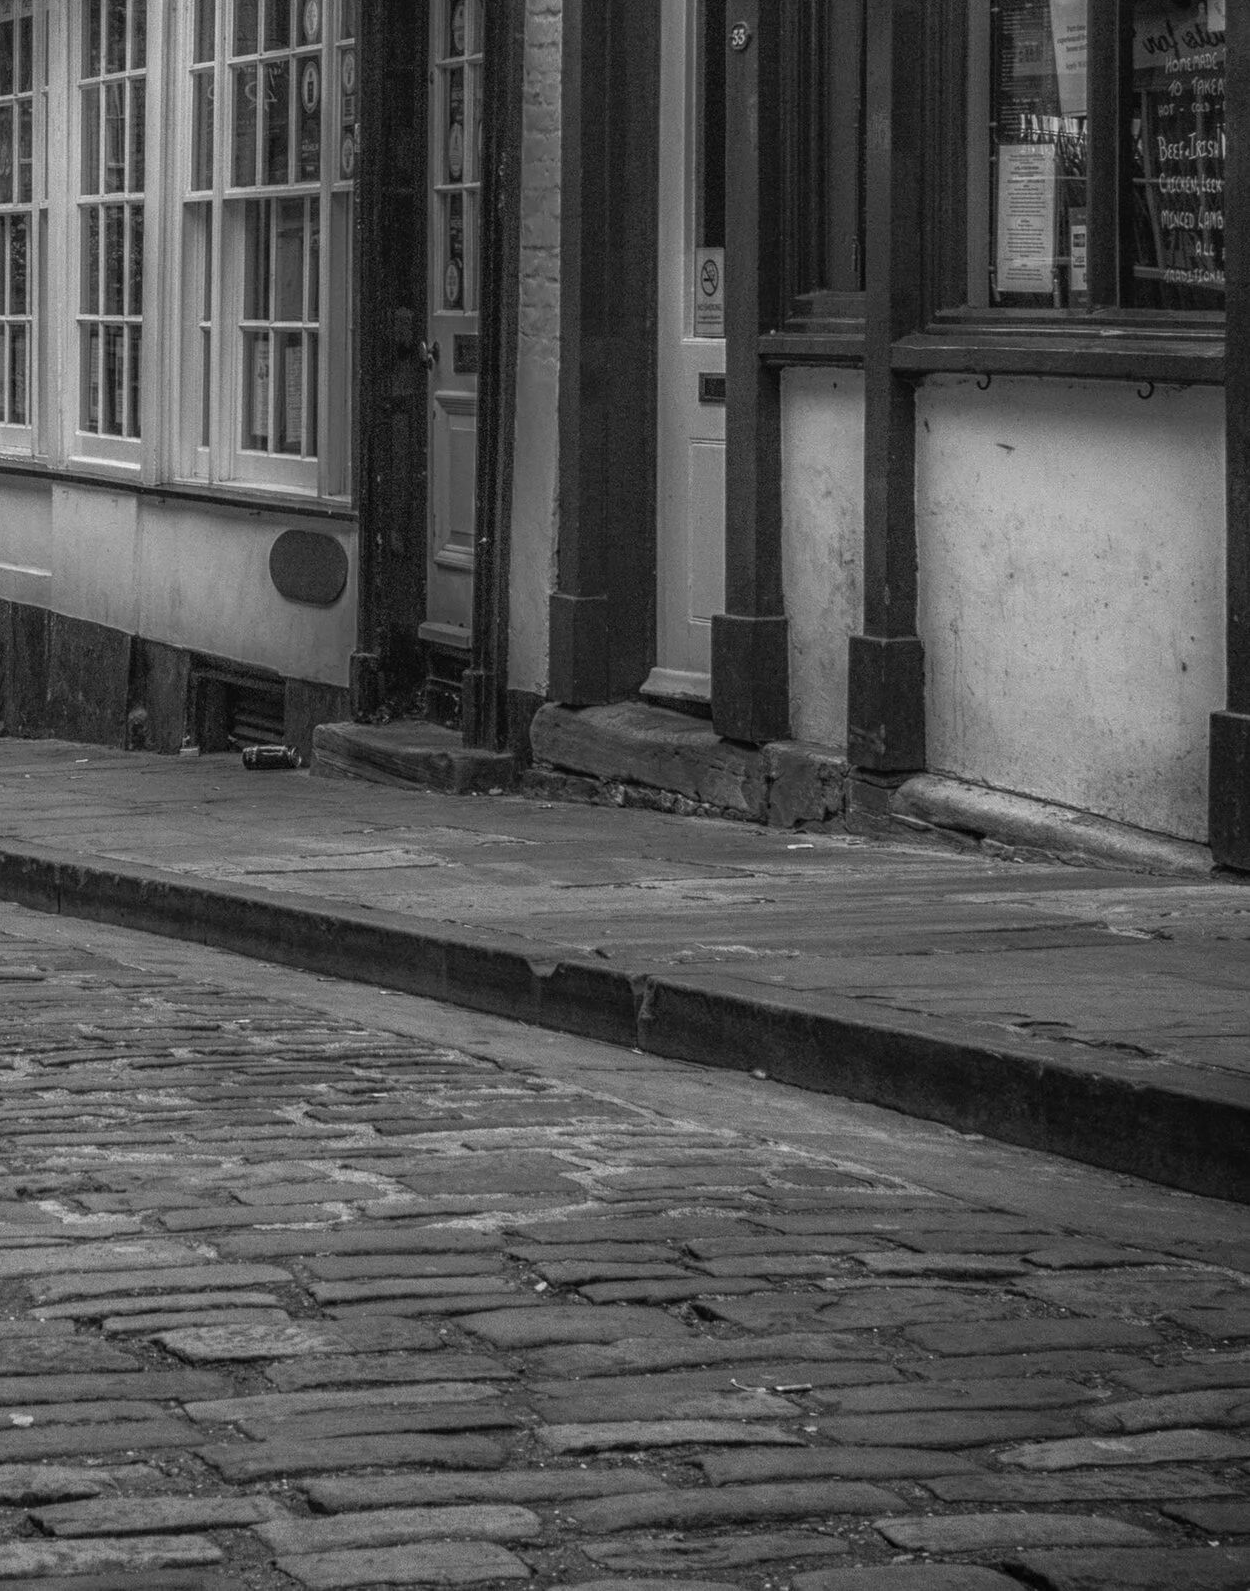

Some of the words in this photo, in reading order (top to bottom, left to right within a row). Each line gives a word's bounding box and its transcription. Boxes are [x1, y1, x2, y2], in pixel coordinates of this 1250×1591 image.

[1165, 52, 1218, 74] HOMEMADE
[1191, 77, 1225, 96] TAKEA
[1161, 210, 1195, 230] MINCED
[1196, 241, 1215, 257] ALL
